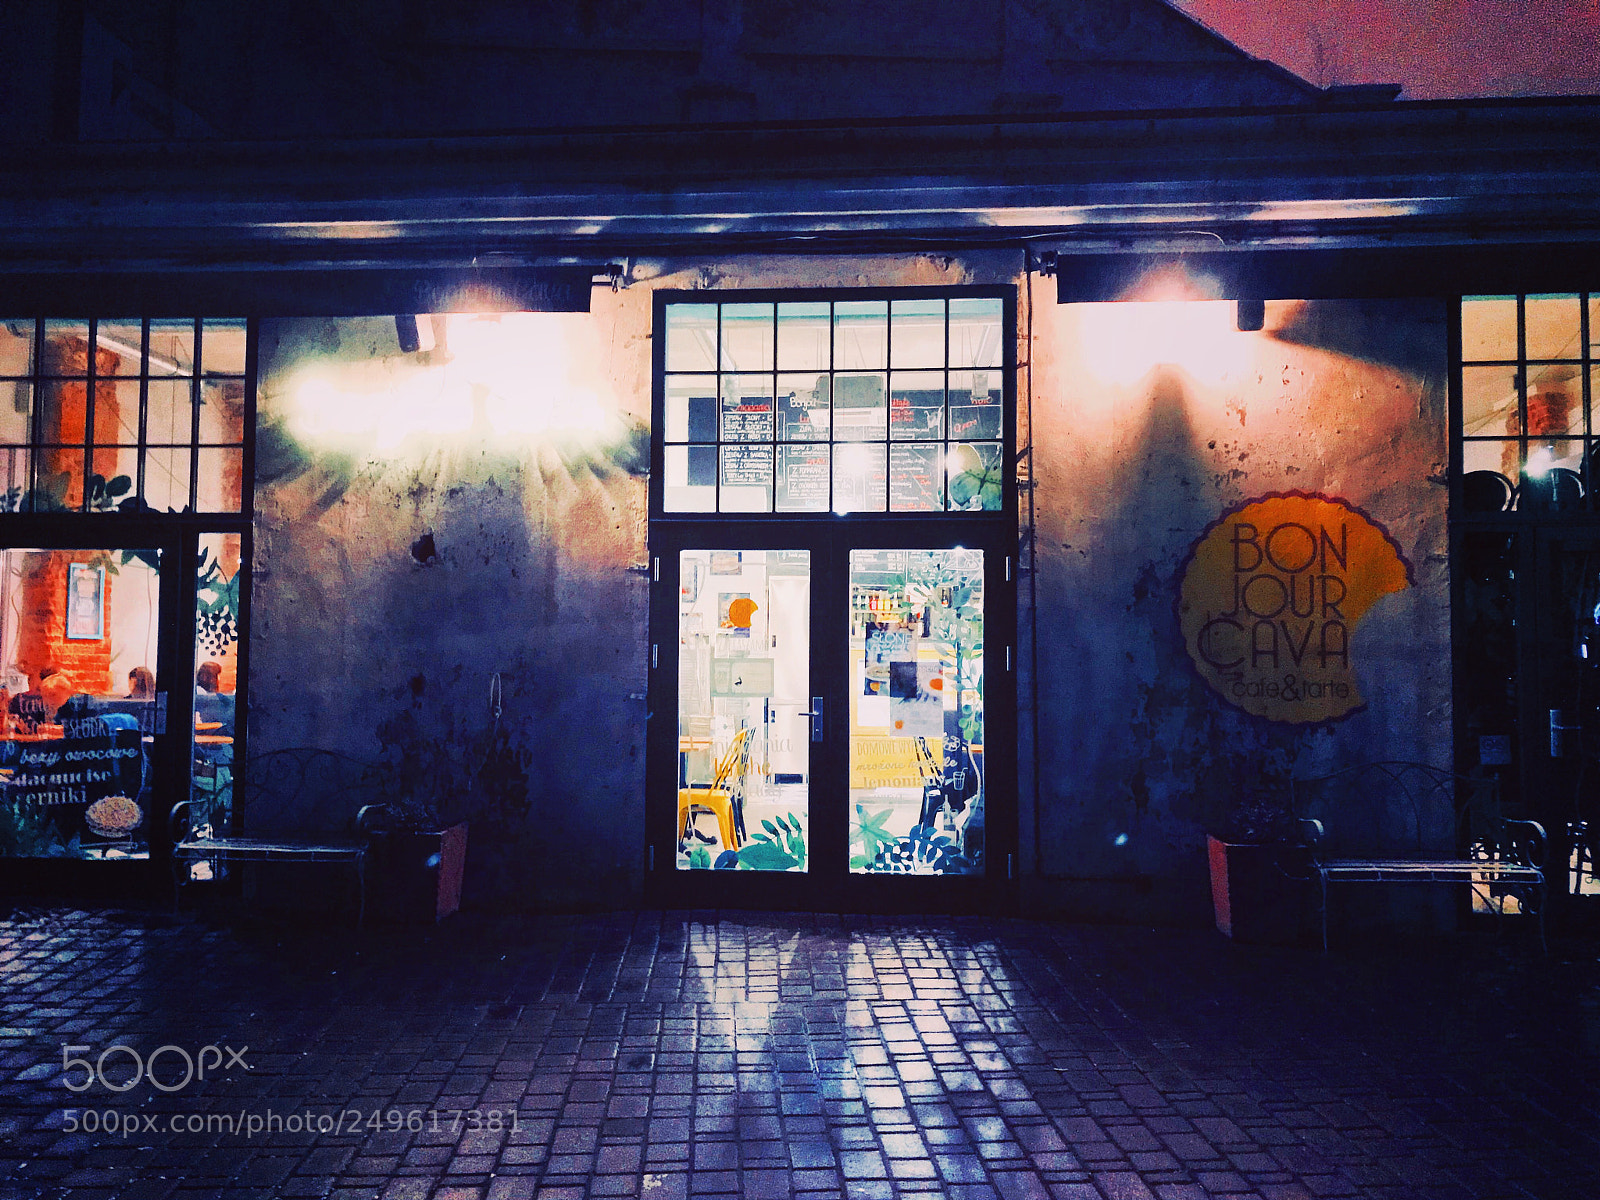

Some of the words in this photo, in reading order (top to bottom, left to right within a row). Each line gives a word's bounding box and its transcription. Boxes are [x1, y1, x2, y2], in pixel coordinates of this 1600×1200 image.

[1230, 521, 1347, 574] BON
[1219, 574, 1347, 619] JOUR
[64, 746, 139, 762] owocowe
